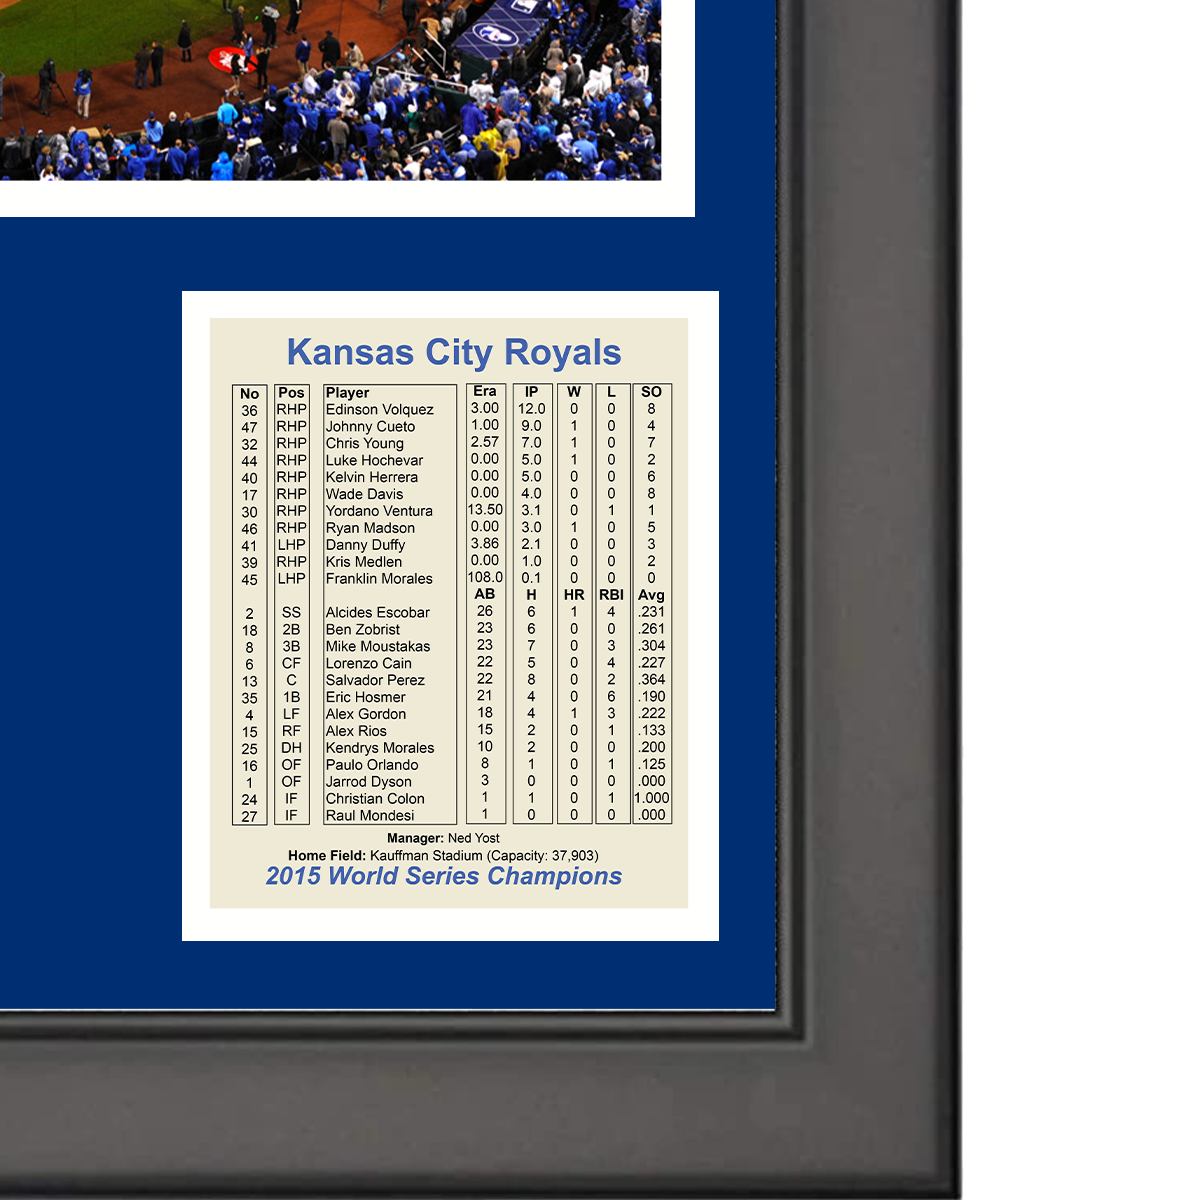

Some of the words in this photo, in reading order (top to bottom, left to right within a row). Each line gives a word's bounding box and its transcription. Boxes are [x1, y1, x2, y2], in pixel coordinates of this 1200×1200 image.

[288, 337, 414, 366] Kansas
[426, 337, 494, 373] City
[505, 337, 622, 373] Royals
[240, 387, 260, 400] No
[278, 386, 305, 399] Pos
[326, 386, 370, 402] Player
[473, 385, 498, 398] Era
[525, 385, 539, 398] IP
[566, 385, 582, 398] W
[607, 385, 617, 398] L
[641, 385, 663, 398] SO
[326, 403, 378, 416] Edinson
[381, 403, 435, 418] Volquez
[325, 420, 373, 436] Johnny
[376, 419, 416, 433] Cueto
[325, 436, 360, 450] Chris
[363, 437, 404, 452] Young
[326, 454, 358, 467] Luke
[361, 454, 424, 467] Hochevar
[326, 470, 365, 483] Kelvin
[369, 470, 419, 483] Herrera
[325, 487, 364, 500] Wade
[367, 487, 404, 500] Davis
[325, 504, 380, 517] Yordano
[382, 504, 433, 517] Ventura
[326, 521, 360, 537] Ryan
[364, 521, 415, 534] Madson
[326, 538, 368, 554] Danny
[372, 538, 406, 554] Duffy
[326, 555, 351, 568] Kris
[355, 555, 402, 568] Medlen
[326, 572, 377, 585] Franklin
[381, 572, 433, 585] Morales
[473, 587, 496, 600] AB
[526, 588, 537, 601] H
[564, 588, 585, 601] HR
[599, 588, 624, 601] RBI
[637, 588, 665, 604] Avg
[325, 606, 373, 619] Alcides
[377, 606, 431, 619] Escobar
[326, 623, 352, 636] Ben
[355, 623, 401, 636] Zobrist
[326, 640, 357, 653] Mike
[360, 640, 431, 653] Moustakas
[326, 657, 379, 670] Lorenzo
[382, 656, 412, 670] Cain
[325, 673, 384, 686] Salvador
[387, 673, 426, 686] Perez
[326, 690, 351, 703] Eric
[355, 690, 407, 703] Hosmer
[325, 707, 355, 720] Alex
[358, 707, 407, 720] Gordon
[325, 724, 355, 737] Alex
[358, 724, 388, 737] Rios
[326, 741, 379, 757] Kendrys
[383, 741, 435, 754] Morales
[326, 758, 363, 771] Paulo
[366, 758, 419, 771] Orlando
[325, 775, 367, 788] Jarrod
[371, 775, 412, 791] Dyson
[325, 792, 383, 805] Christian
[387, 792, 425, 805] Colon
[326, 809, 356, 822] Raul
[360, 809, 415, 822] Mondesi
[387, 832, 444, 846] Manager:
[448, 832, 472, 844] Ned
[474, 832, 500, 844] Yost
[288, 849, 327, 862] Home
[330, 849, 366, 862] Field:
[370, 849, 429, 862] Kauffman
[432, 849, 483, 862] Stadium
[486, 849, 548, 864] (Capacity:
[552, 849, 599, 864] 37,903)
[265, 865, 322, 885] 2015
[329, 865, 400, 885] World
[405, 865, 480, 885] Series
[487, 865, 623, 890] Champions
